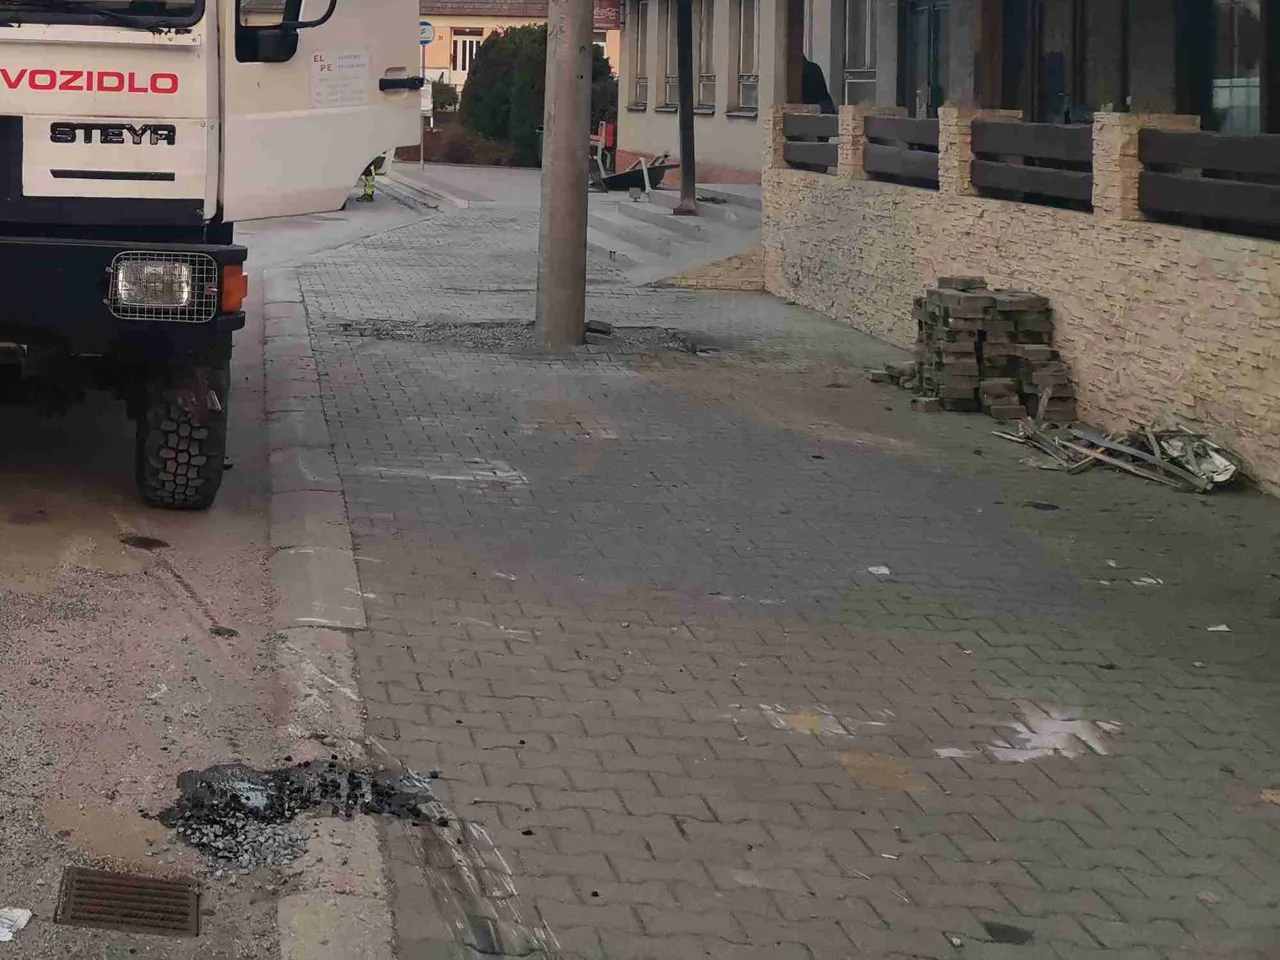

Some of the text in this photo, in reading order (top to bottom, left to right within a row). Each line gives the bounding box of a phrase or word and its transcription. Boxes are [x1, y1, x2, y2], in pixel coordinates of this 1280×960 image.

[313, 54, 324, 63] EL
[320, 63, 333, 72] PE
[0, 68, 179, 94] VOZIDLO
[50, 121, 177, 146] STEYR
